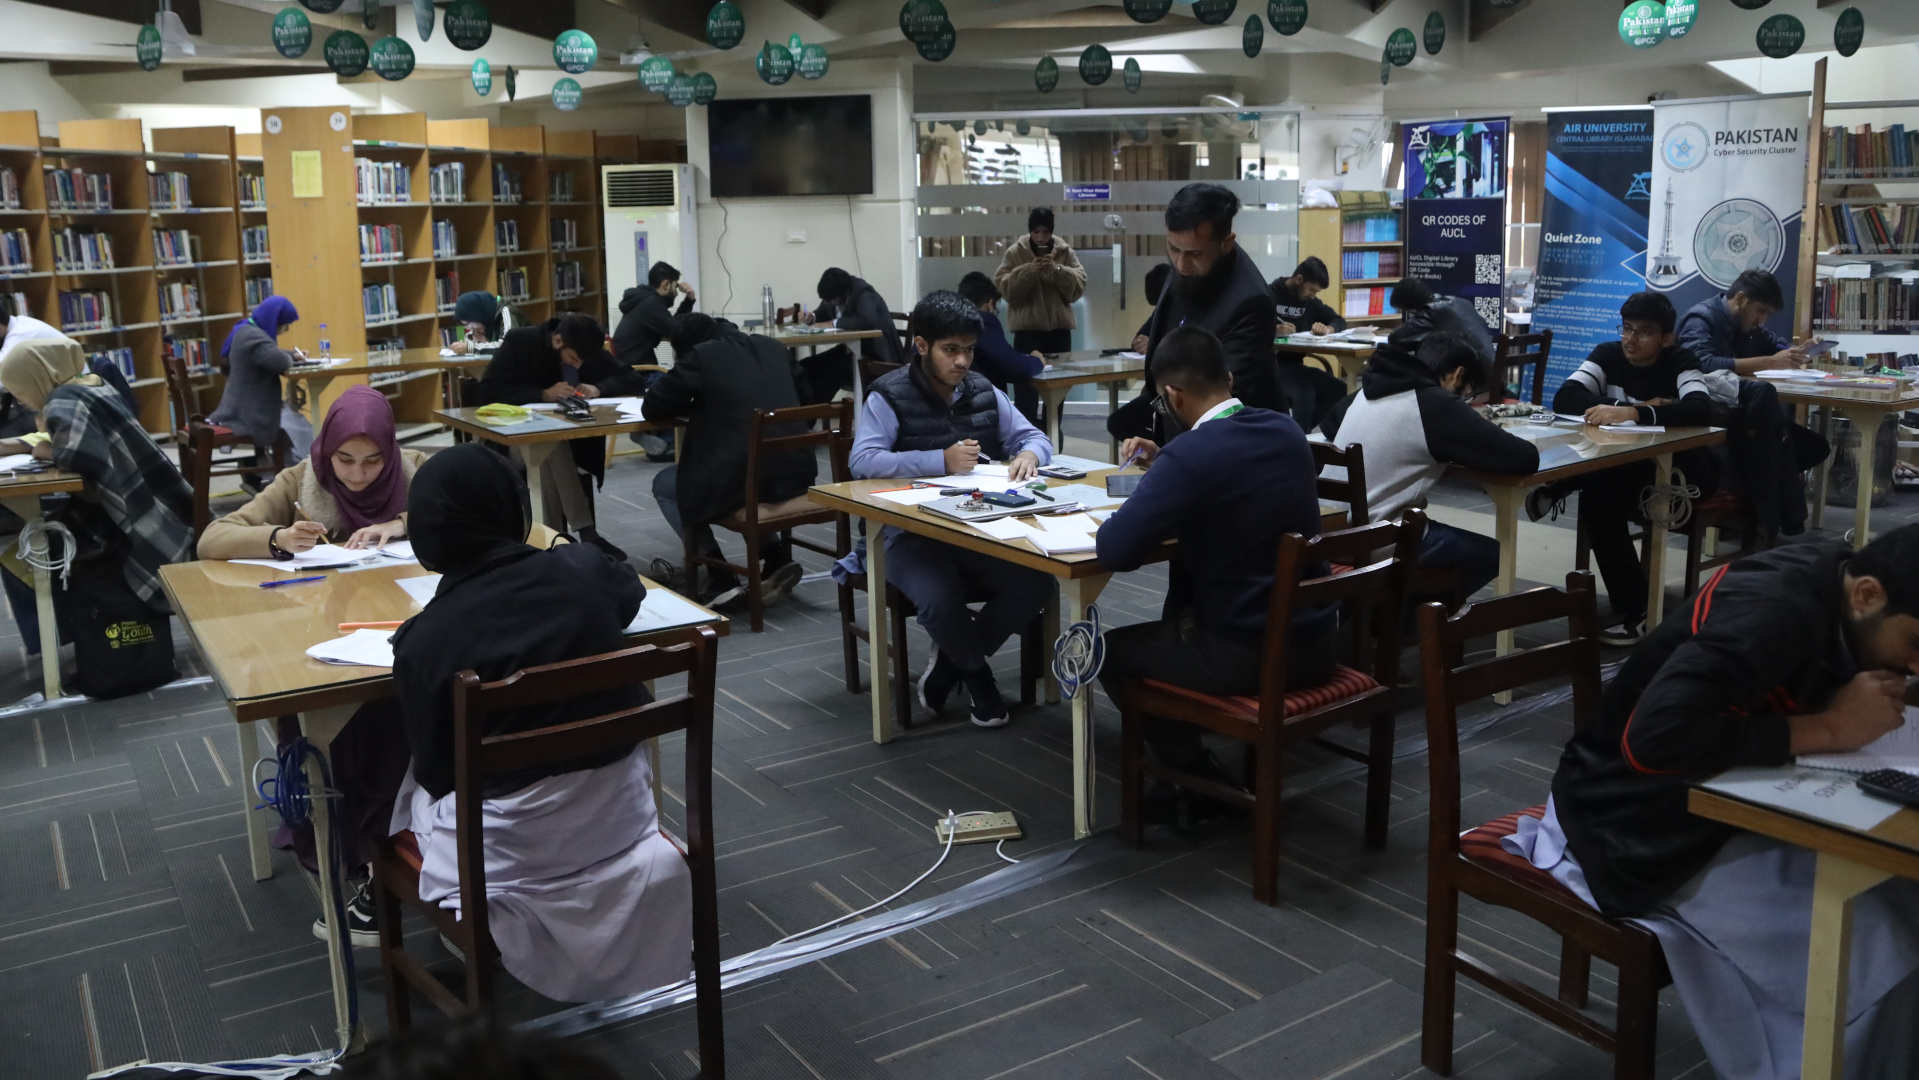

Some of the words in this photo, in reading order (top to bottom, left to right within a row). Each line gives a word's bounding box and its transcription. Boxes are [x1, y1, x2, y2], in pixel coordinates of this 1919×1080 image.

[1623, 17, 1665, 30] Pakistan
[556, 45, 594, 56] Pakistan
[1563, 123, 1582, 133] AIR
[1583, 122, 1647, 133] UNIVERSITY
[1715, 128, 1798, 145] PAKISTAN
[1713, 149, 1735, 157] Cyber
[1737, 147, 1767, 156] Security
[1769, 146, 1796, 154] Cluster
[1422, 215, 1436, 226] QR
[1437, 215, 1471, 225] CODES
[1472, 215, 1486, 225] OF
[1440, 228, 1466, 238] AUCL
[1544, 232, 1573, 243] Quiet
[1574, 234, 1602, 245] Zone
